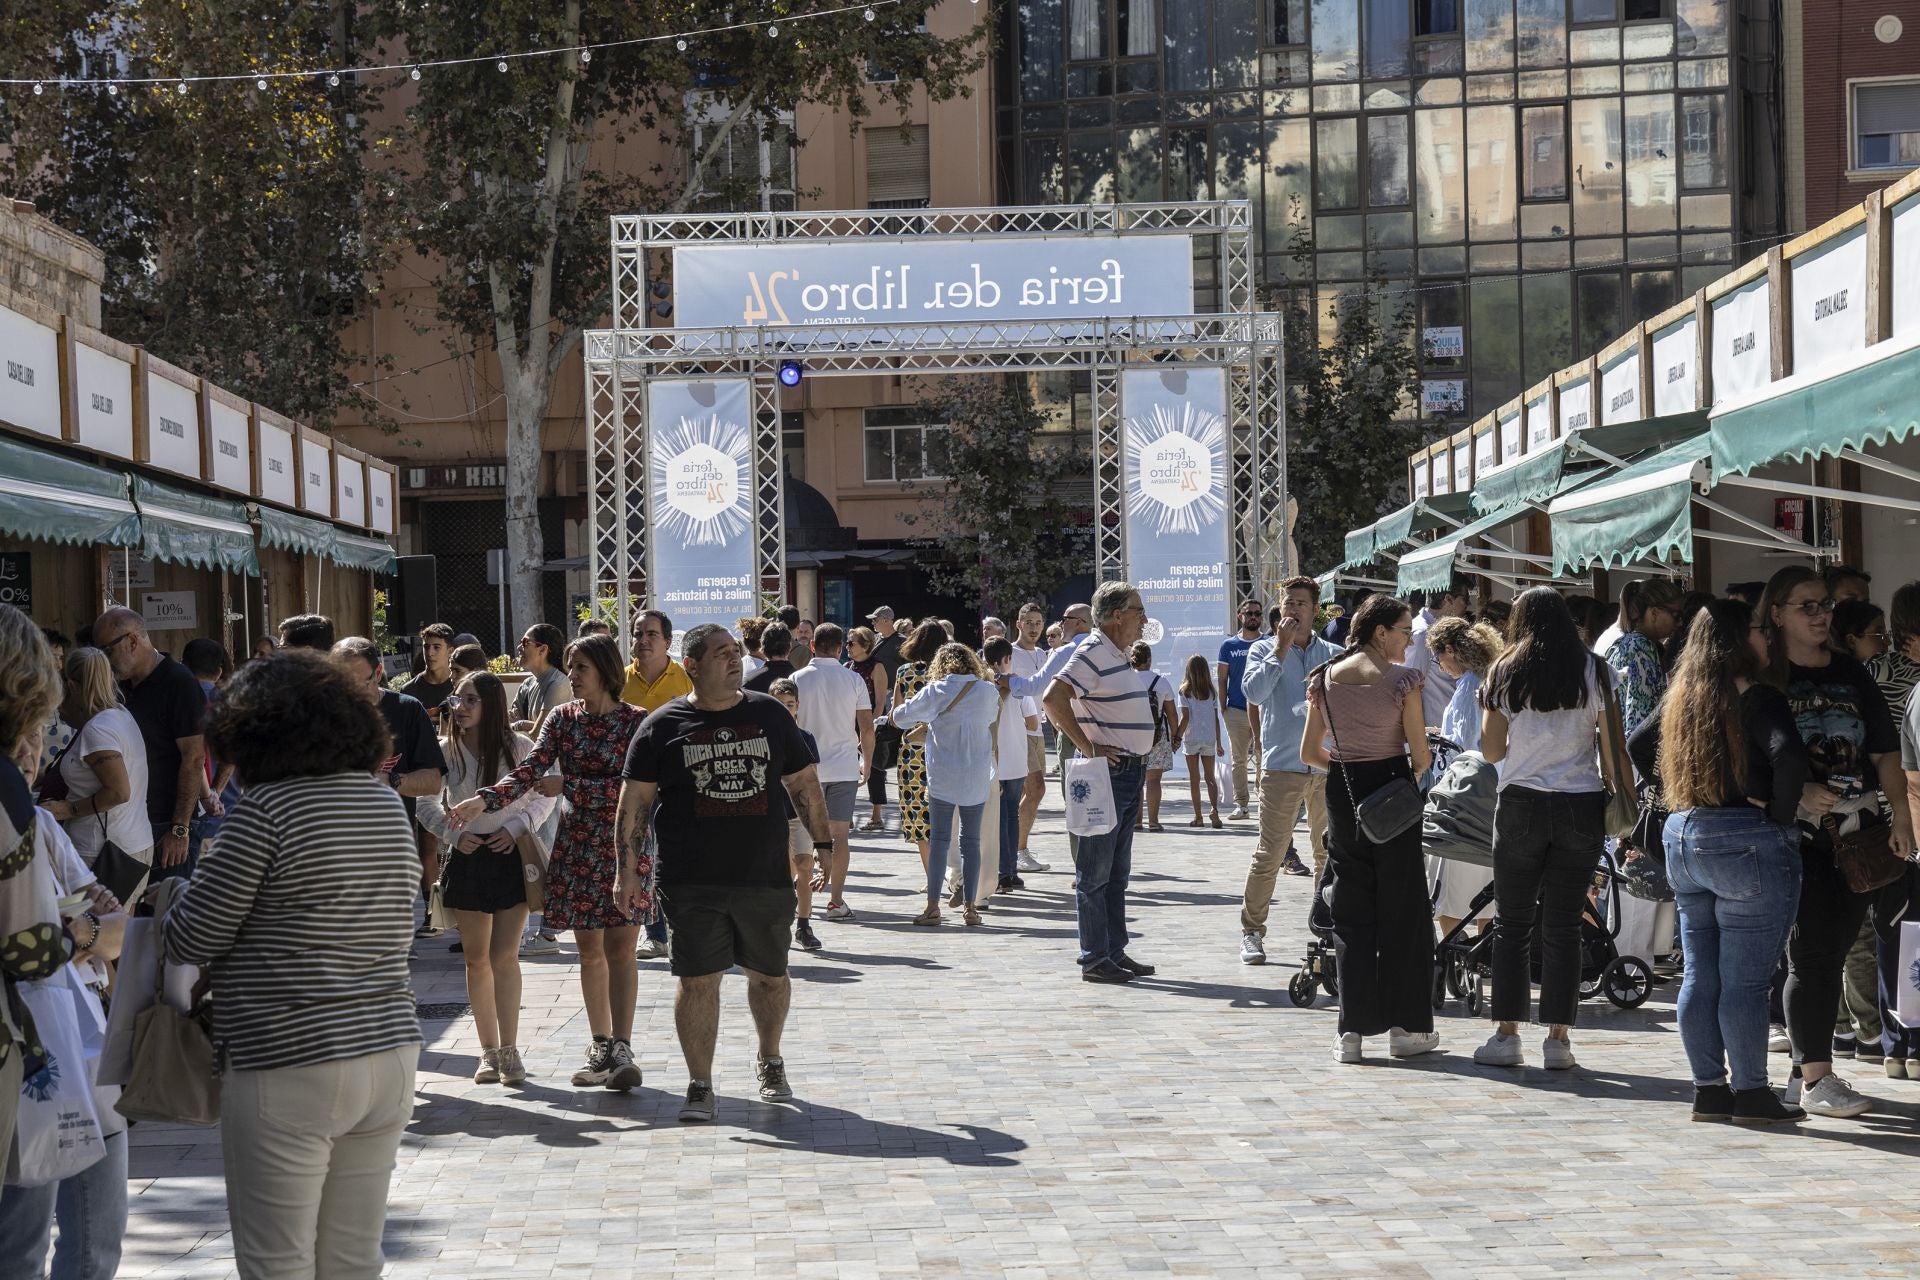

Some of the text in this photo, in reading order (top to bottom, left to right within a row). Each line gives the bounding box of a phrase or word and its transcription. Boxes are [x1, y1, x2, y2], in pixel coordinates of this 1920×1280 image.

[1815, 295, 1832, 321] EDITORIAL
[156, 603, 183, 616] 10%
[683, 736, 770, 768] ROCK IMPERIUM
[714, 759, 746, 770] ROCK
[719, 780, 744, 791] WAY
